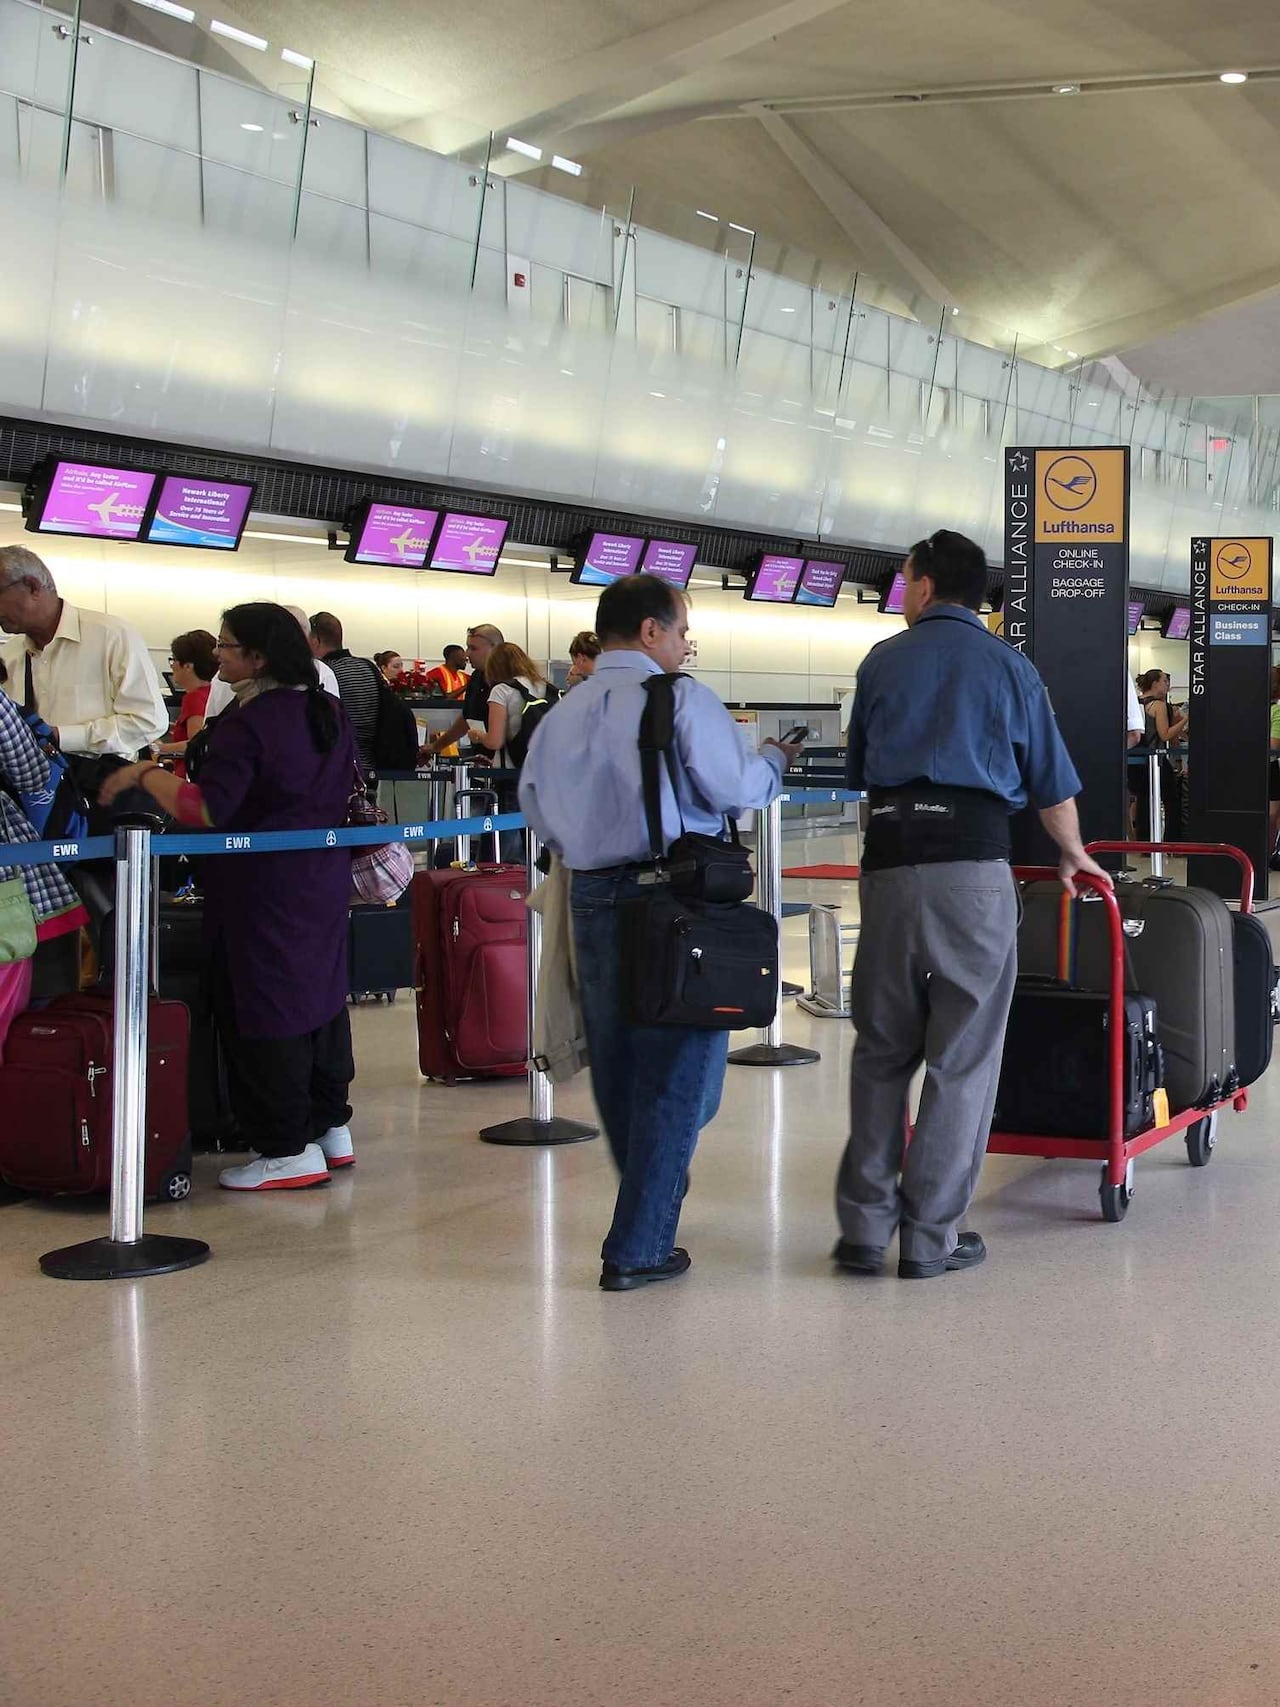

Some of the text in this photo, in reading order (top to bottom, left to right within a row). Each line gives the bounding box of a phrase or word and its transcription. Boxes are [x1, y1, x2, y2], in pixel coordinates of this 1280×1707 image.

[182, 487, 230, 500] Newark Liberty
[184, 496, 226, 506] International
[169, 511, 189, 519] Service
[1043, 520, 1114, 534] Lufthansa
[1059, 549, 1098, 559] ONLINE
[1053, 560, 1104, 569] CHECK-IN
[1010, 484, 1028, 656] AR ALLIANCE
[1052, 578, 1104, 587] BAGGAGE
[1051, 589, 1106, 598] DROP-OFF
[1216, 586, 1262, 594] Lufthansa
[1193, 561, 1206, 694] STAR ALLIANCE
[1215, 621, 1259, 630] Business
[1215, 632, 1242, 640] Class
[404, 826, 424, 837] EWR
[226, 837, 250, 849] EWR
[53, 844, 78, 857] EWR
